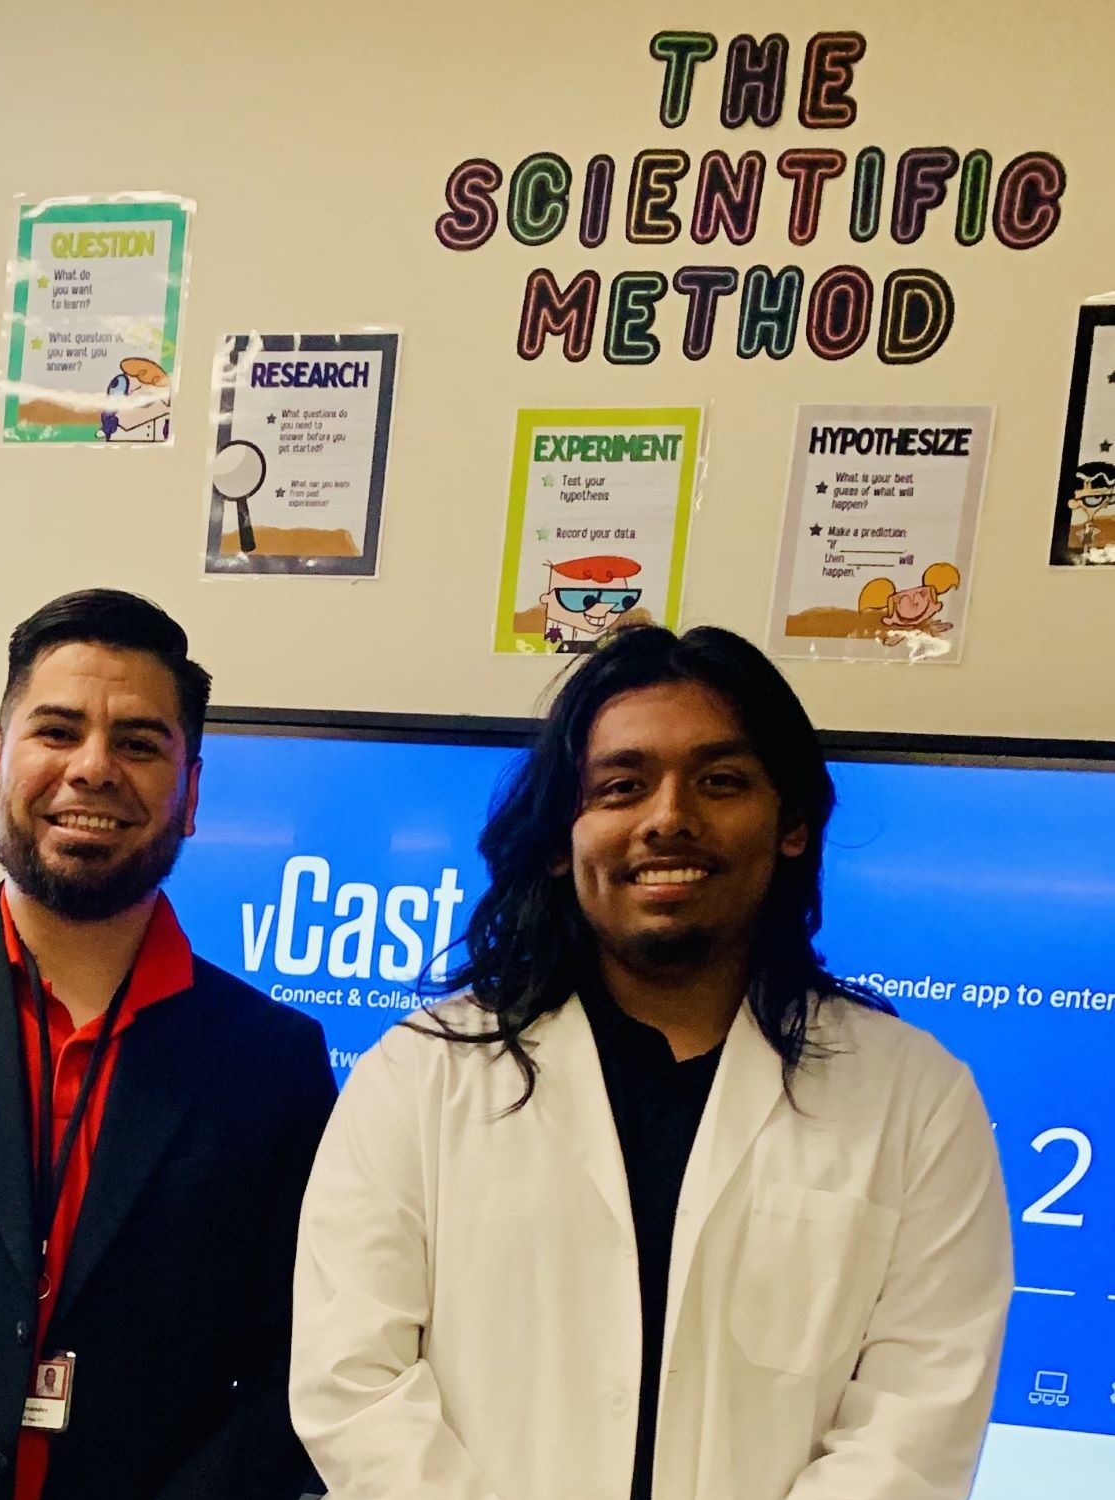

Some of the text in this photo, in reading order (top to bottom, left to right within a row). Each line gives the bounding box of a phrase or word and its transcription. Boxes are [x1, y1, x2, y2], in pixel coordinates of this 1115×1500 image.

[650, 31, 867, 128] THE
[435, 147, 1067, 251] SCIENTIFIC
[51, 230, 155, 258] QUESTION
[54, 269, 91, 280] What do
[53, 284, 92, 297] you want
[52, 298, 90, 309] to learn?
[516, 265, 955, 365] METHOD
[49, 332, 71, 343] What
[75, 331, 112, 344] question
[47, 346, 107, 359] you want you
[46, 360, 82, 371] answer?
[251, 361, 370, 388] RESEARCH
[281, 409, 300, 418] What
[339, 408, 348, 418] do
[280, 421, 322, 431] you need to
[307, 432, 330, 441] before
[333, 434, 346, 443] you
[809, 426, 973, 456] HYPOTHESIZE
[278, 444, 290, 454] get
[534, 434, 683, 462] EXPERIMENT
[563, 474, 605, 488] Test your
[836, 472, 914, 484] What is your best
[559, 490, 609, 503] hypothesis
[833, 486, 914, 497] guess of what will
[831, 499, 868, 511] happen?
[556, 527, 636, 541] Record your data
[827, 526, 851, 536] Make
[852, 528, 859, 537] a
[824, 553, 914, 565] then will
[241, 855, 464, 982] vCast
[270, 984, 342, 1006] Connect
[347, 987, 362, 1007] &
[961, 984, 1010, 1009] app
[1017, 984, 1043, 1006] to
[1050, 988, 1115, 1010] enter
[1022, 1127, 1092, 1227] 2
